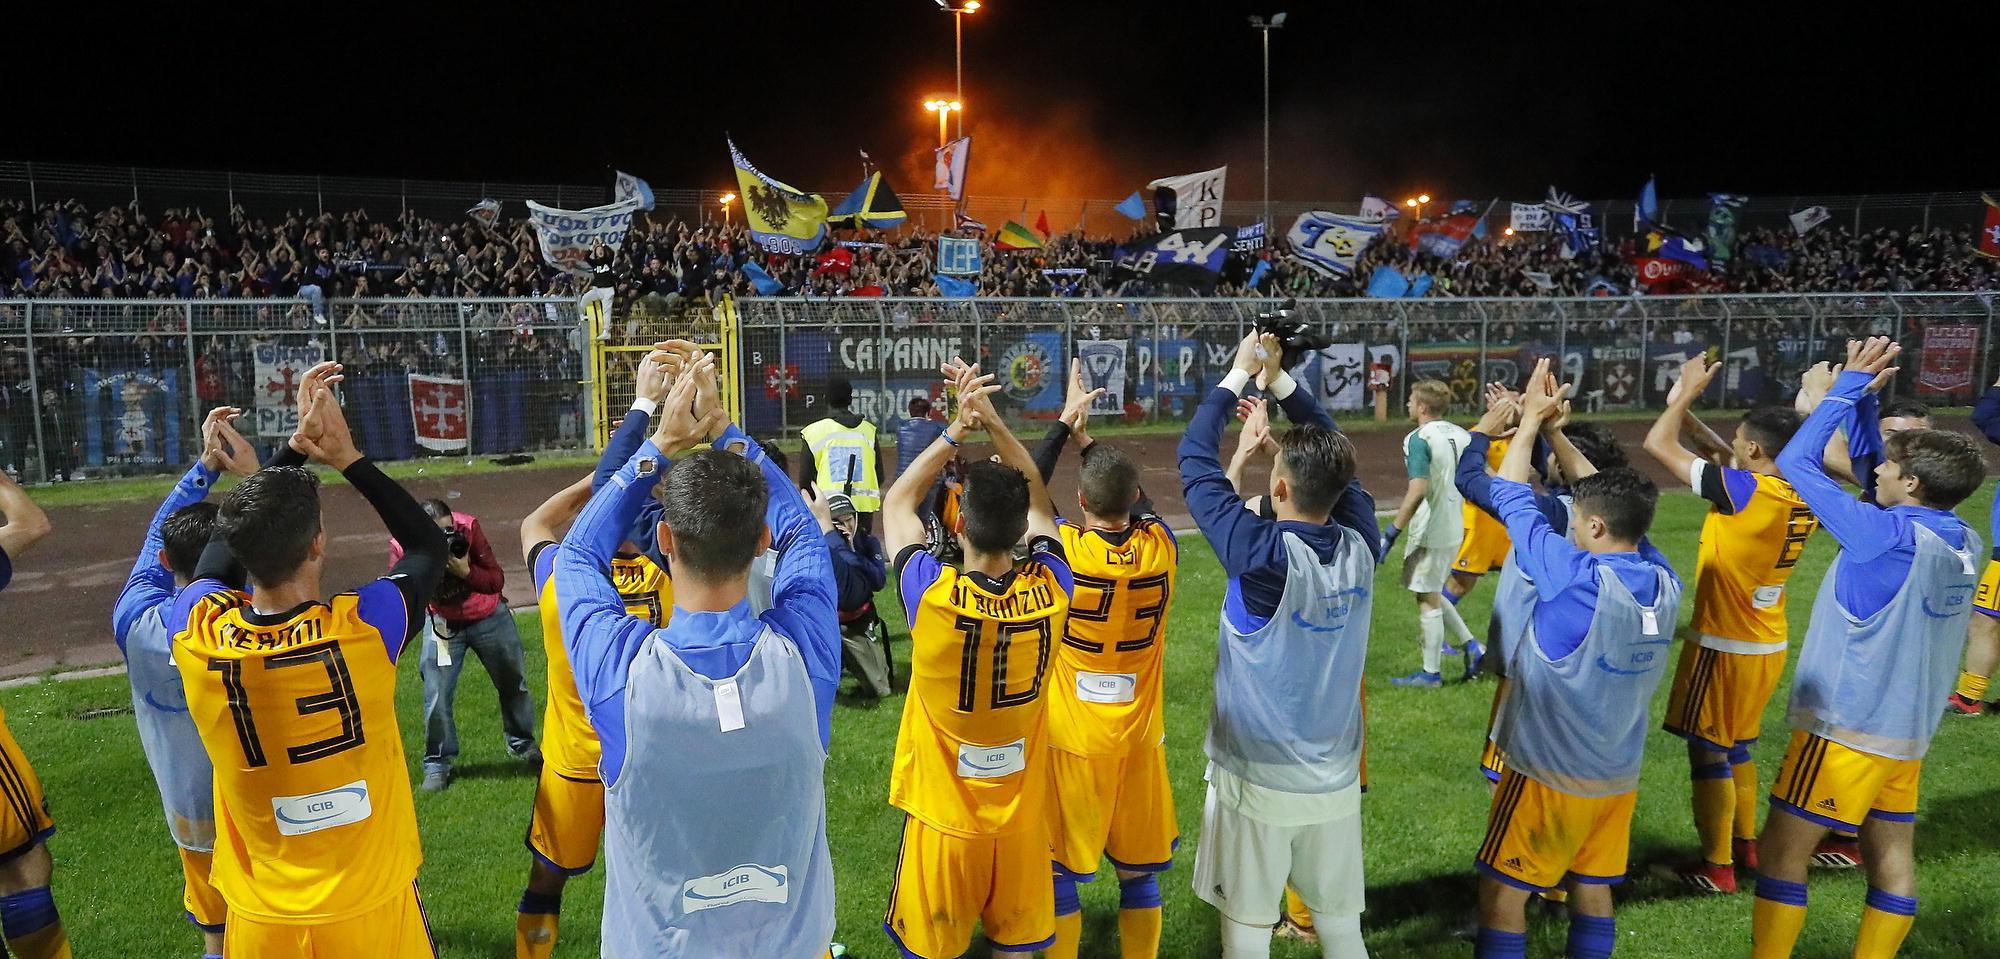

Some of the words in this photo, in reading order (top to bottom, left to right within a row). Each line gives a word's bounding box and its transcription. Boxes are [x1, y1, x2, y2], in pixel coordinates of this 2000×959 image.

[941, 241, 979, 272] CEP
[840, 337, 962, 374] CAPANNE
[258, 408, 299, 433] PIS
[1061, 571, 1169, 654] 23
[953, 614, 1051, 713] 10
[1098, 681, 1116, 689] ICIB
[207, 639, 366, 768] 13
[986, 753, 1005, 763] ICIB
[306, 801, 334, 813] ICIB
[722, 874, 750, 890] ICIB
